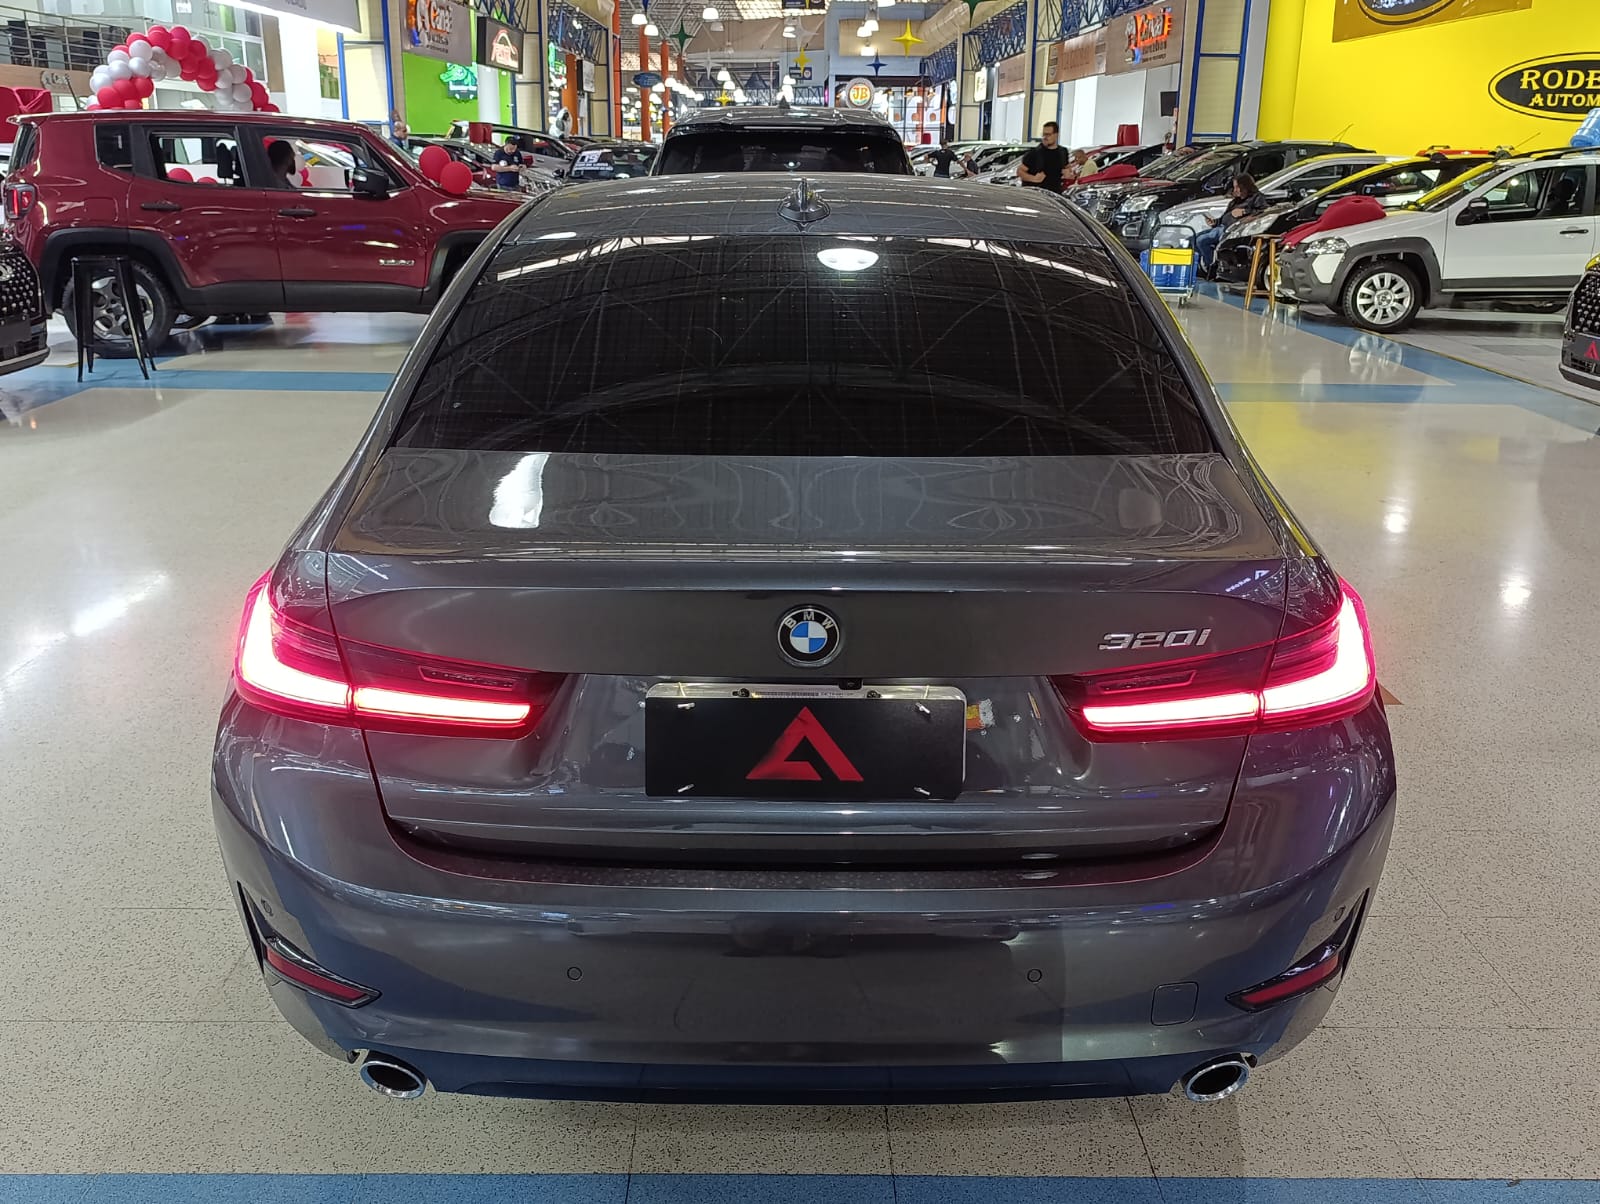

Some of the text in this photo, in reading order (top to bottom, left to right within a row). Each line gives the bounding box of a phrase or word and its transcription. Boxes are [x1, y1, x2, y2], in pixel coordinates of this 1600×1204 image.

[853, 87, 868, 100] JB
[1528, 93, 1600, 107] AUTOM
[784, 611, 835, 629] BMW
[1099, 628, 1211, 650] 320i
